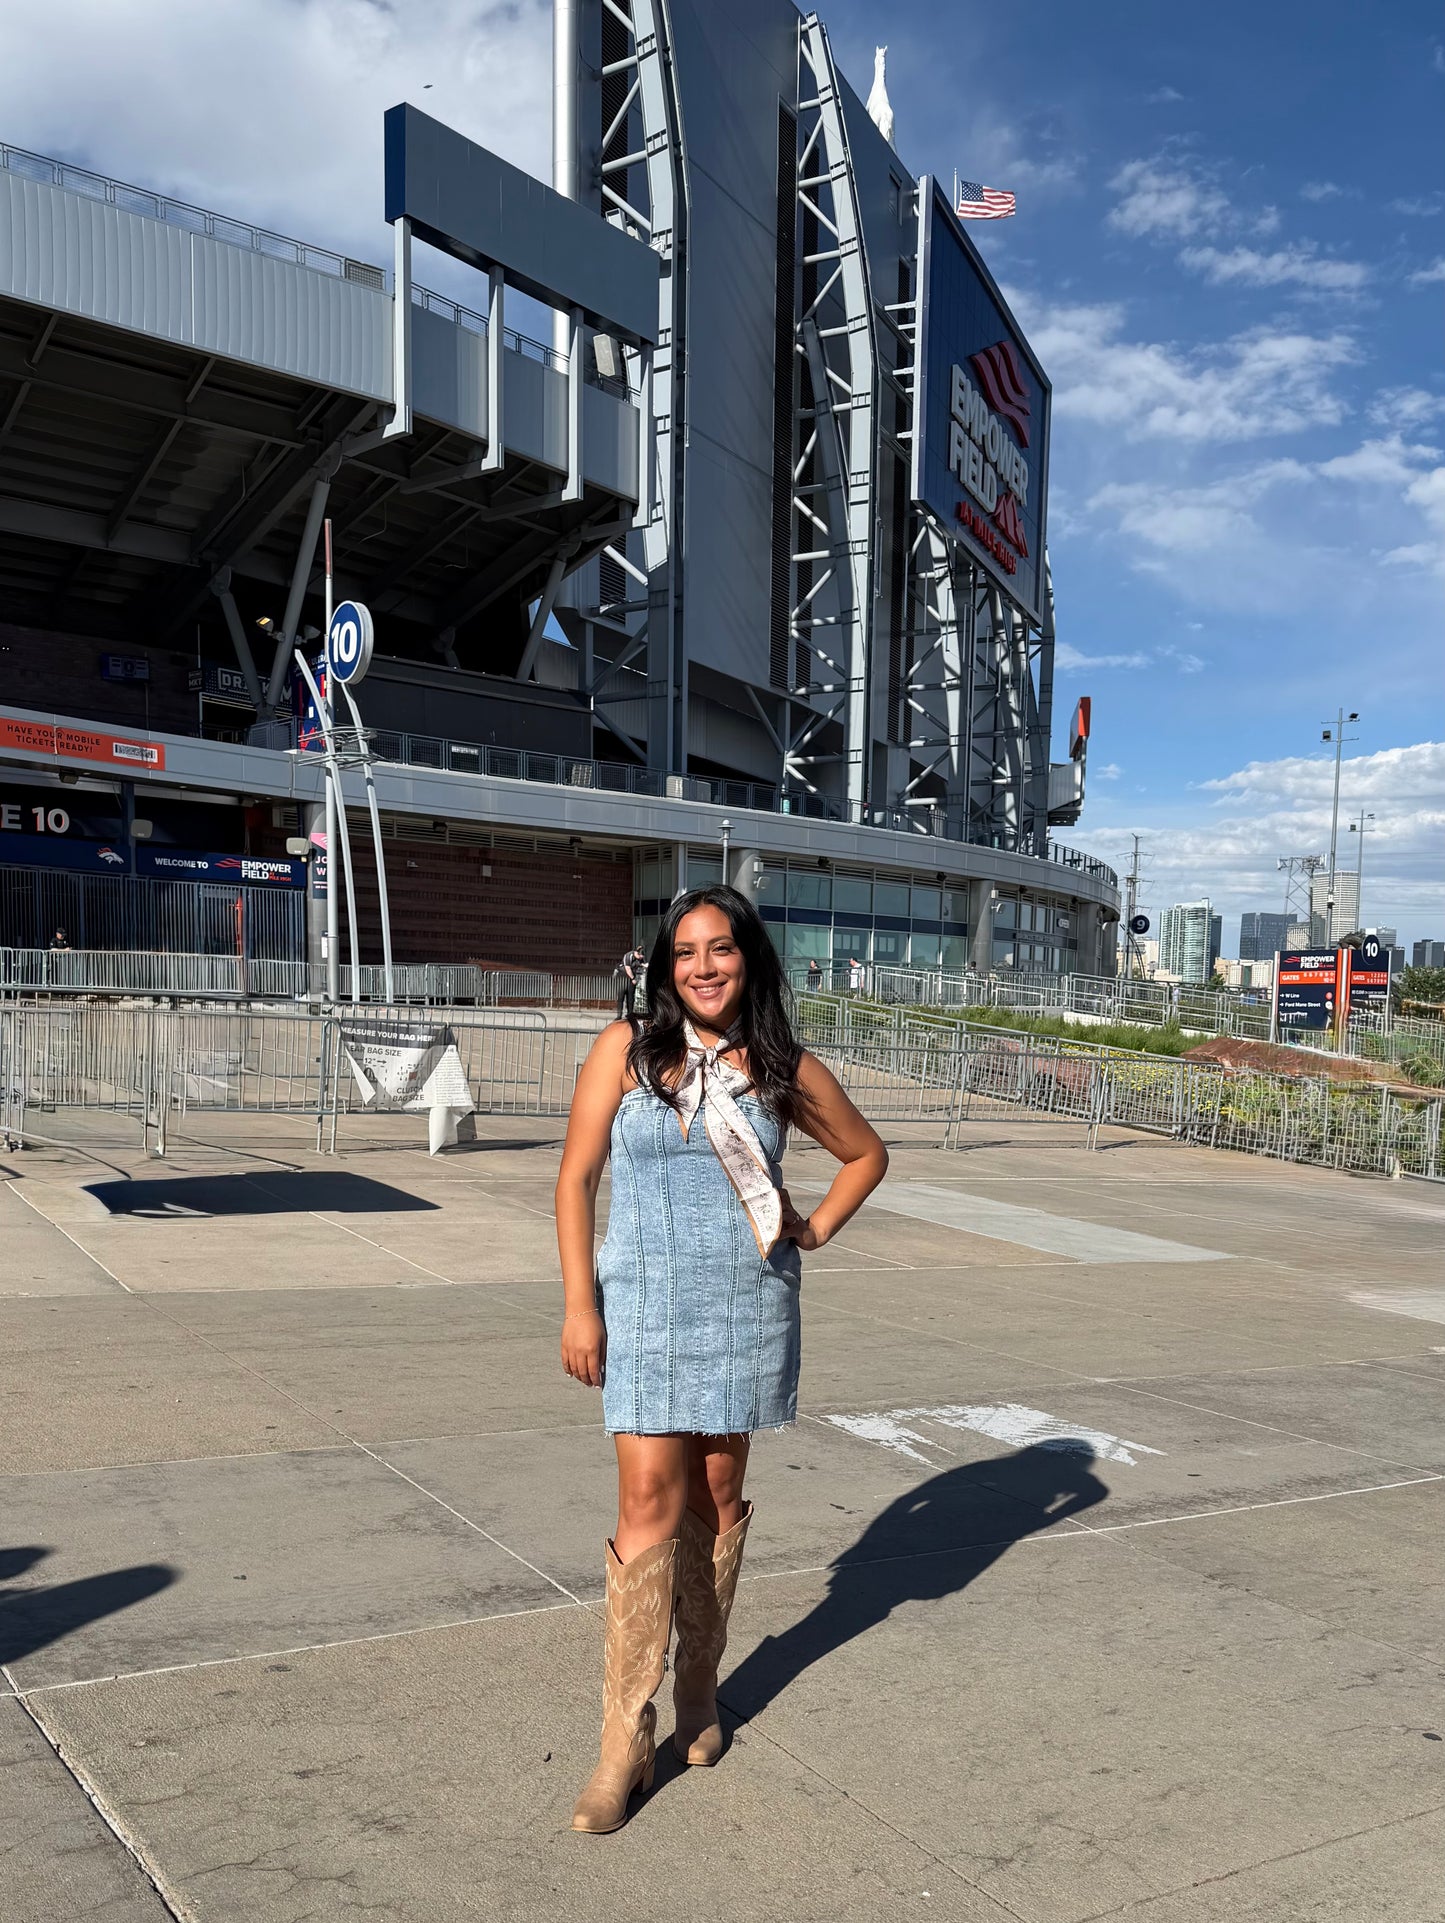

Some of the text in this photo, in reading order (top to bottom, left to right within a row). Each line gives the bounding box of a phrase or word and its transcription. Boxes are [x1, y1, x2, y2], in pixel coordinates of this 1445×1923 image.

[951, 364, 1028, 507] EMPOWER
[950, 421, 998, 513] FIELD
[973, 516, 996, 551] MILE
[995, 541, 1017, 575] HIGH
[331, 621, 358, 663] 10
[7, 725, 101, 746] HAVE YOUR MOBILE
[16, 735, 93, 753] TICKETS READY!
[32, 806, 70, 834] 10
[155, 857, 209, 869] WELCOME TO
[241, 860, 292, 874] EMPOWER
[241, 869, 270, 880] FIELD
[1136, 919, 1146, 930] 9
[1365, 942, 1379, 958] 10
[341, 1027, 376, 1037] MEASURE
[377, 1031, 397, 1039] YOUR
[399, 1033, 416, 1041] BAG
[367, 1047, 383, 1055] BAG
[409, 1094, 425, 1102] SIZE
